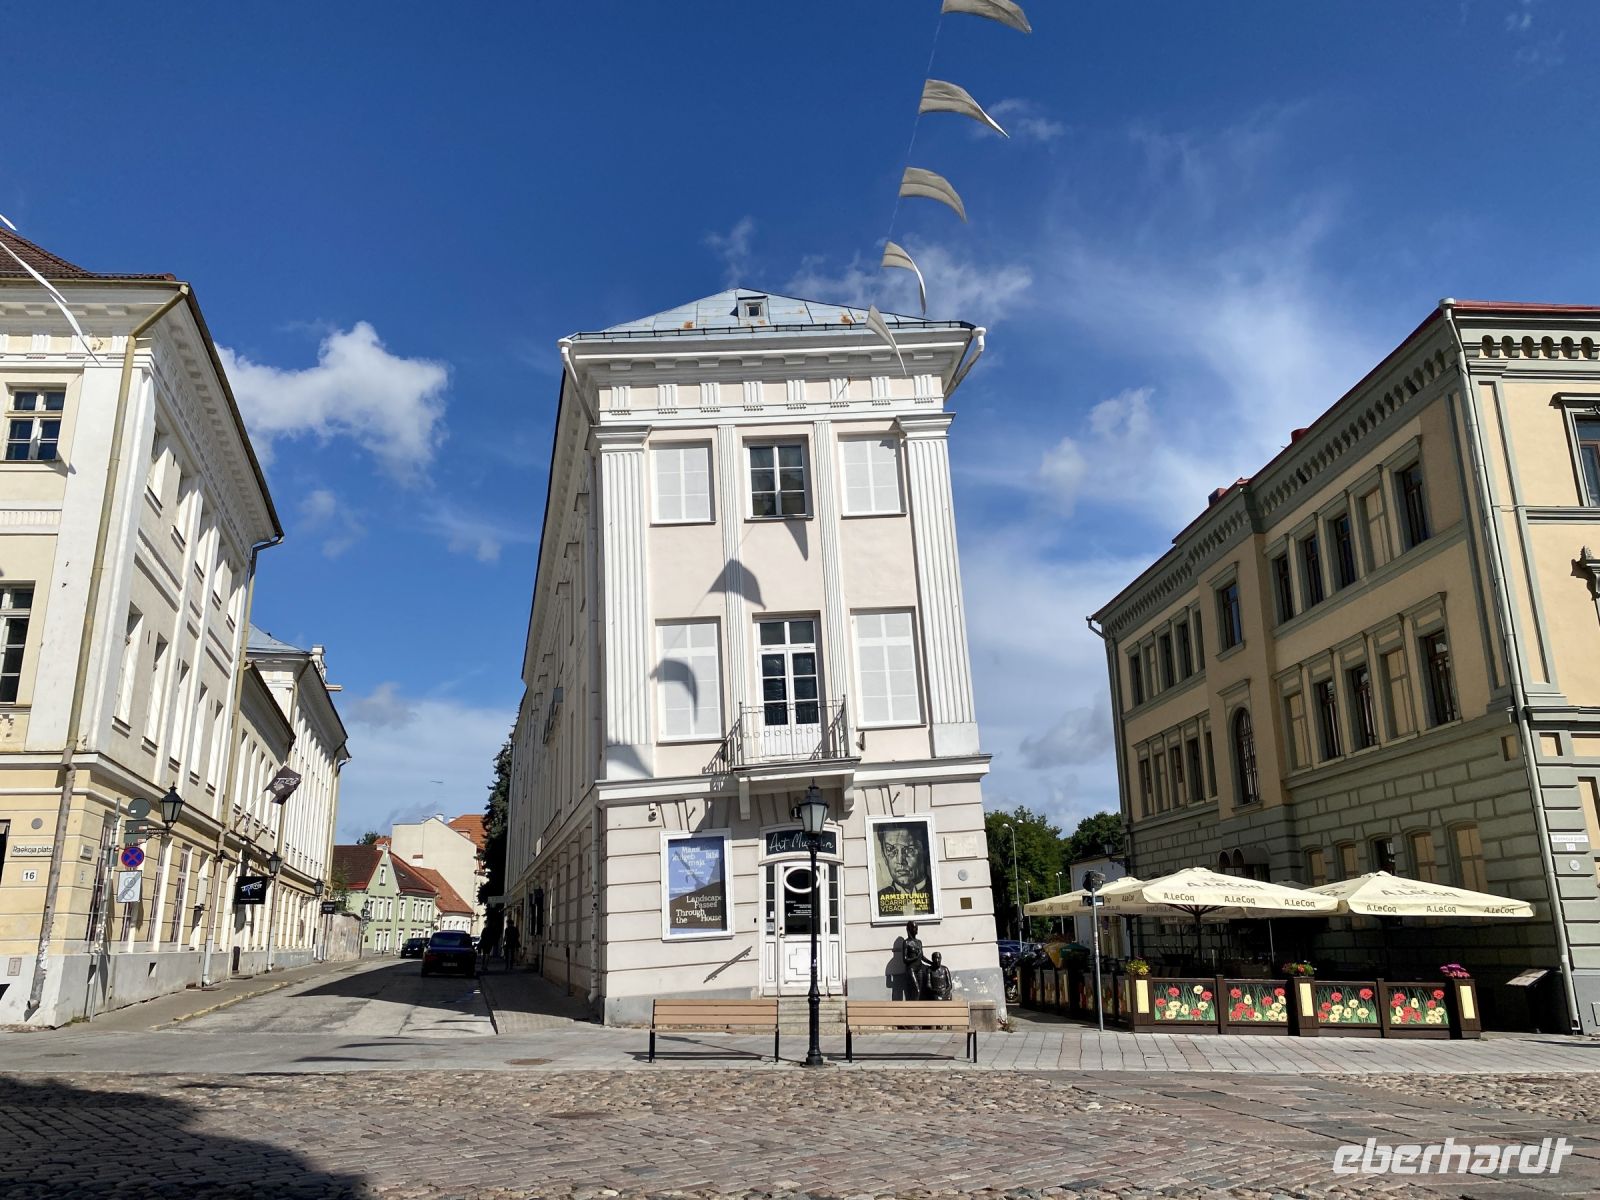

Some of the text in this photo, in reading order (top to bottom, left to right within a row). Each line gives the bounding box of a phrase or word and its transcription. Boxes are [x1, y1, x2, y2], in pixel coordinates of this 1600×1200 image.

[768, 832, 789, 852] Art
[12, 845, 52, 854] Raekoja plats
[25, 872, 35, 880] 16
[694, 901, 718, 909] Passes
[676, 908, 705, 918] Through
[676, 914, 722, 924] the House
